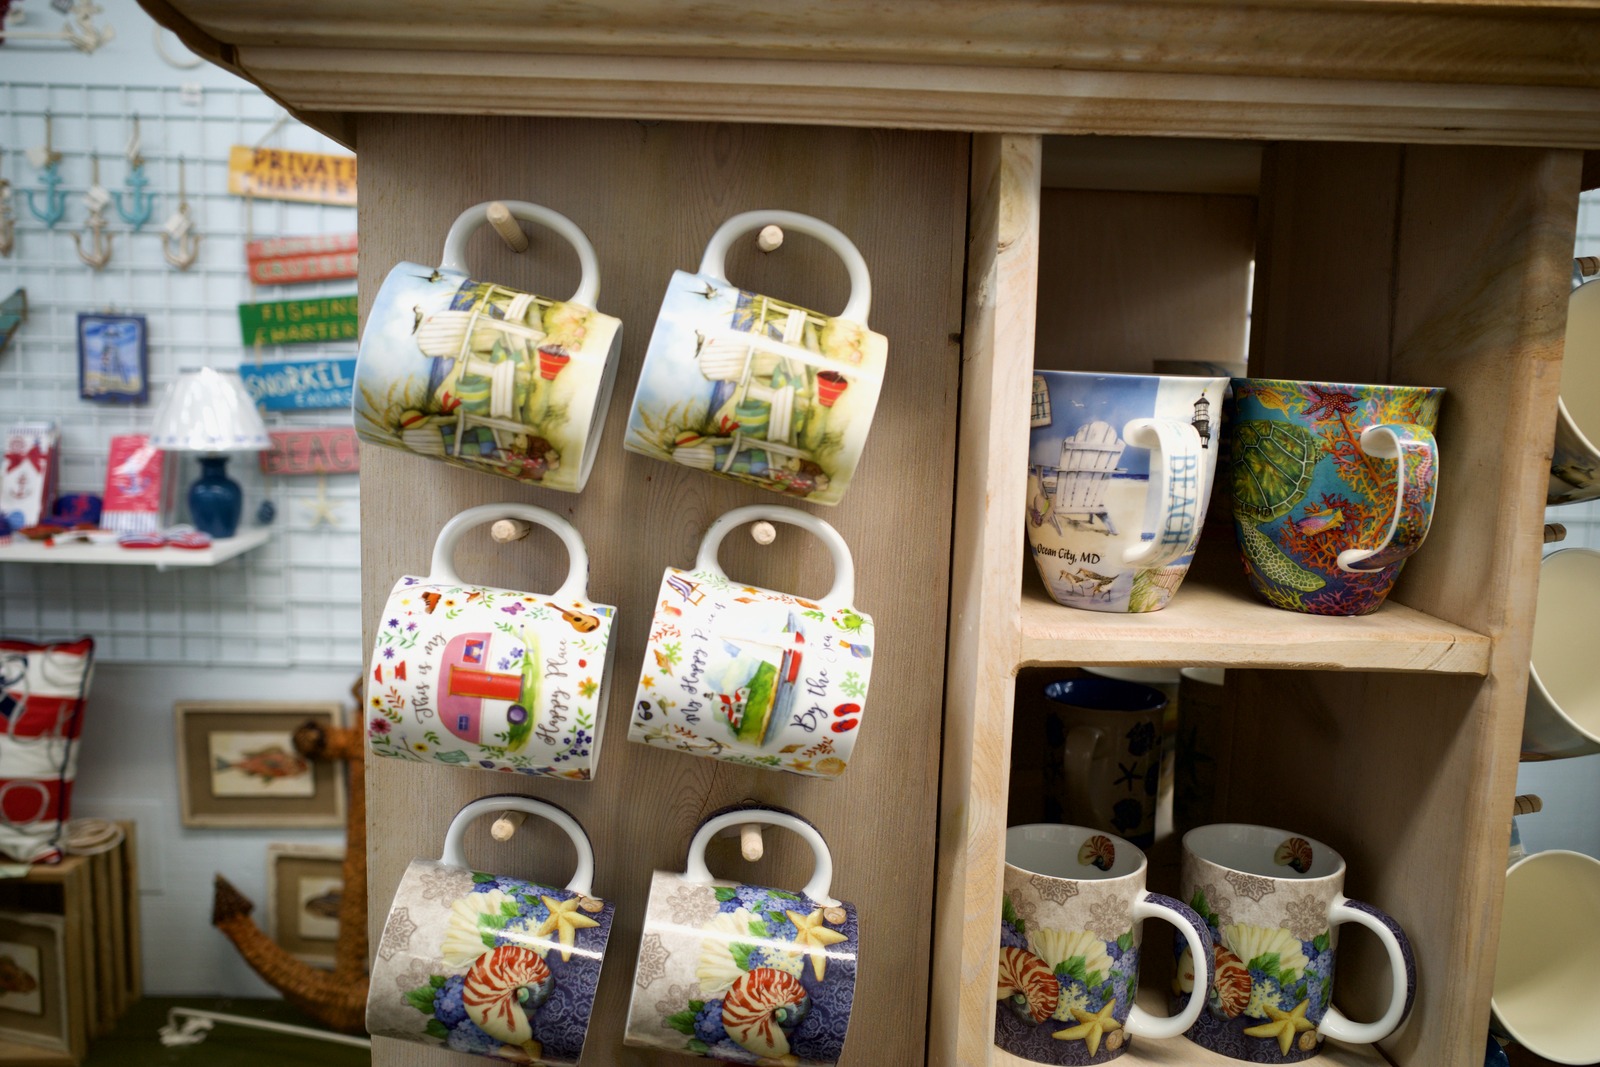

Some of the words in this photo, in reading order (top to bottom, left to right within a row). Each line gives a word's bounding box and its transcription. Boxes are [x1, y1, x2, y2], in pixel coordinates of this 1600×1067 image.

[245, 362, 351, 399] SNORKEL
[1161, 454, 1196, 546] BEACH
[1037, 543, 1056, 557] Ocean
[1058, 548, 1077, 565] City,
[1080, 552, 1100, 565] MD
[424, 631, 447, 656] my
[544, 638, 569, 679] Place
[418, 661, 433, 675] is
[680, 648, 708, 695] Happy
[805, 668, 829, 697] the
[411, 677, 434, 725] This
[535, 686, 571, 746] Happy
[680, 699, 703, 726] My
[789, 702, 828, 733] By
